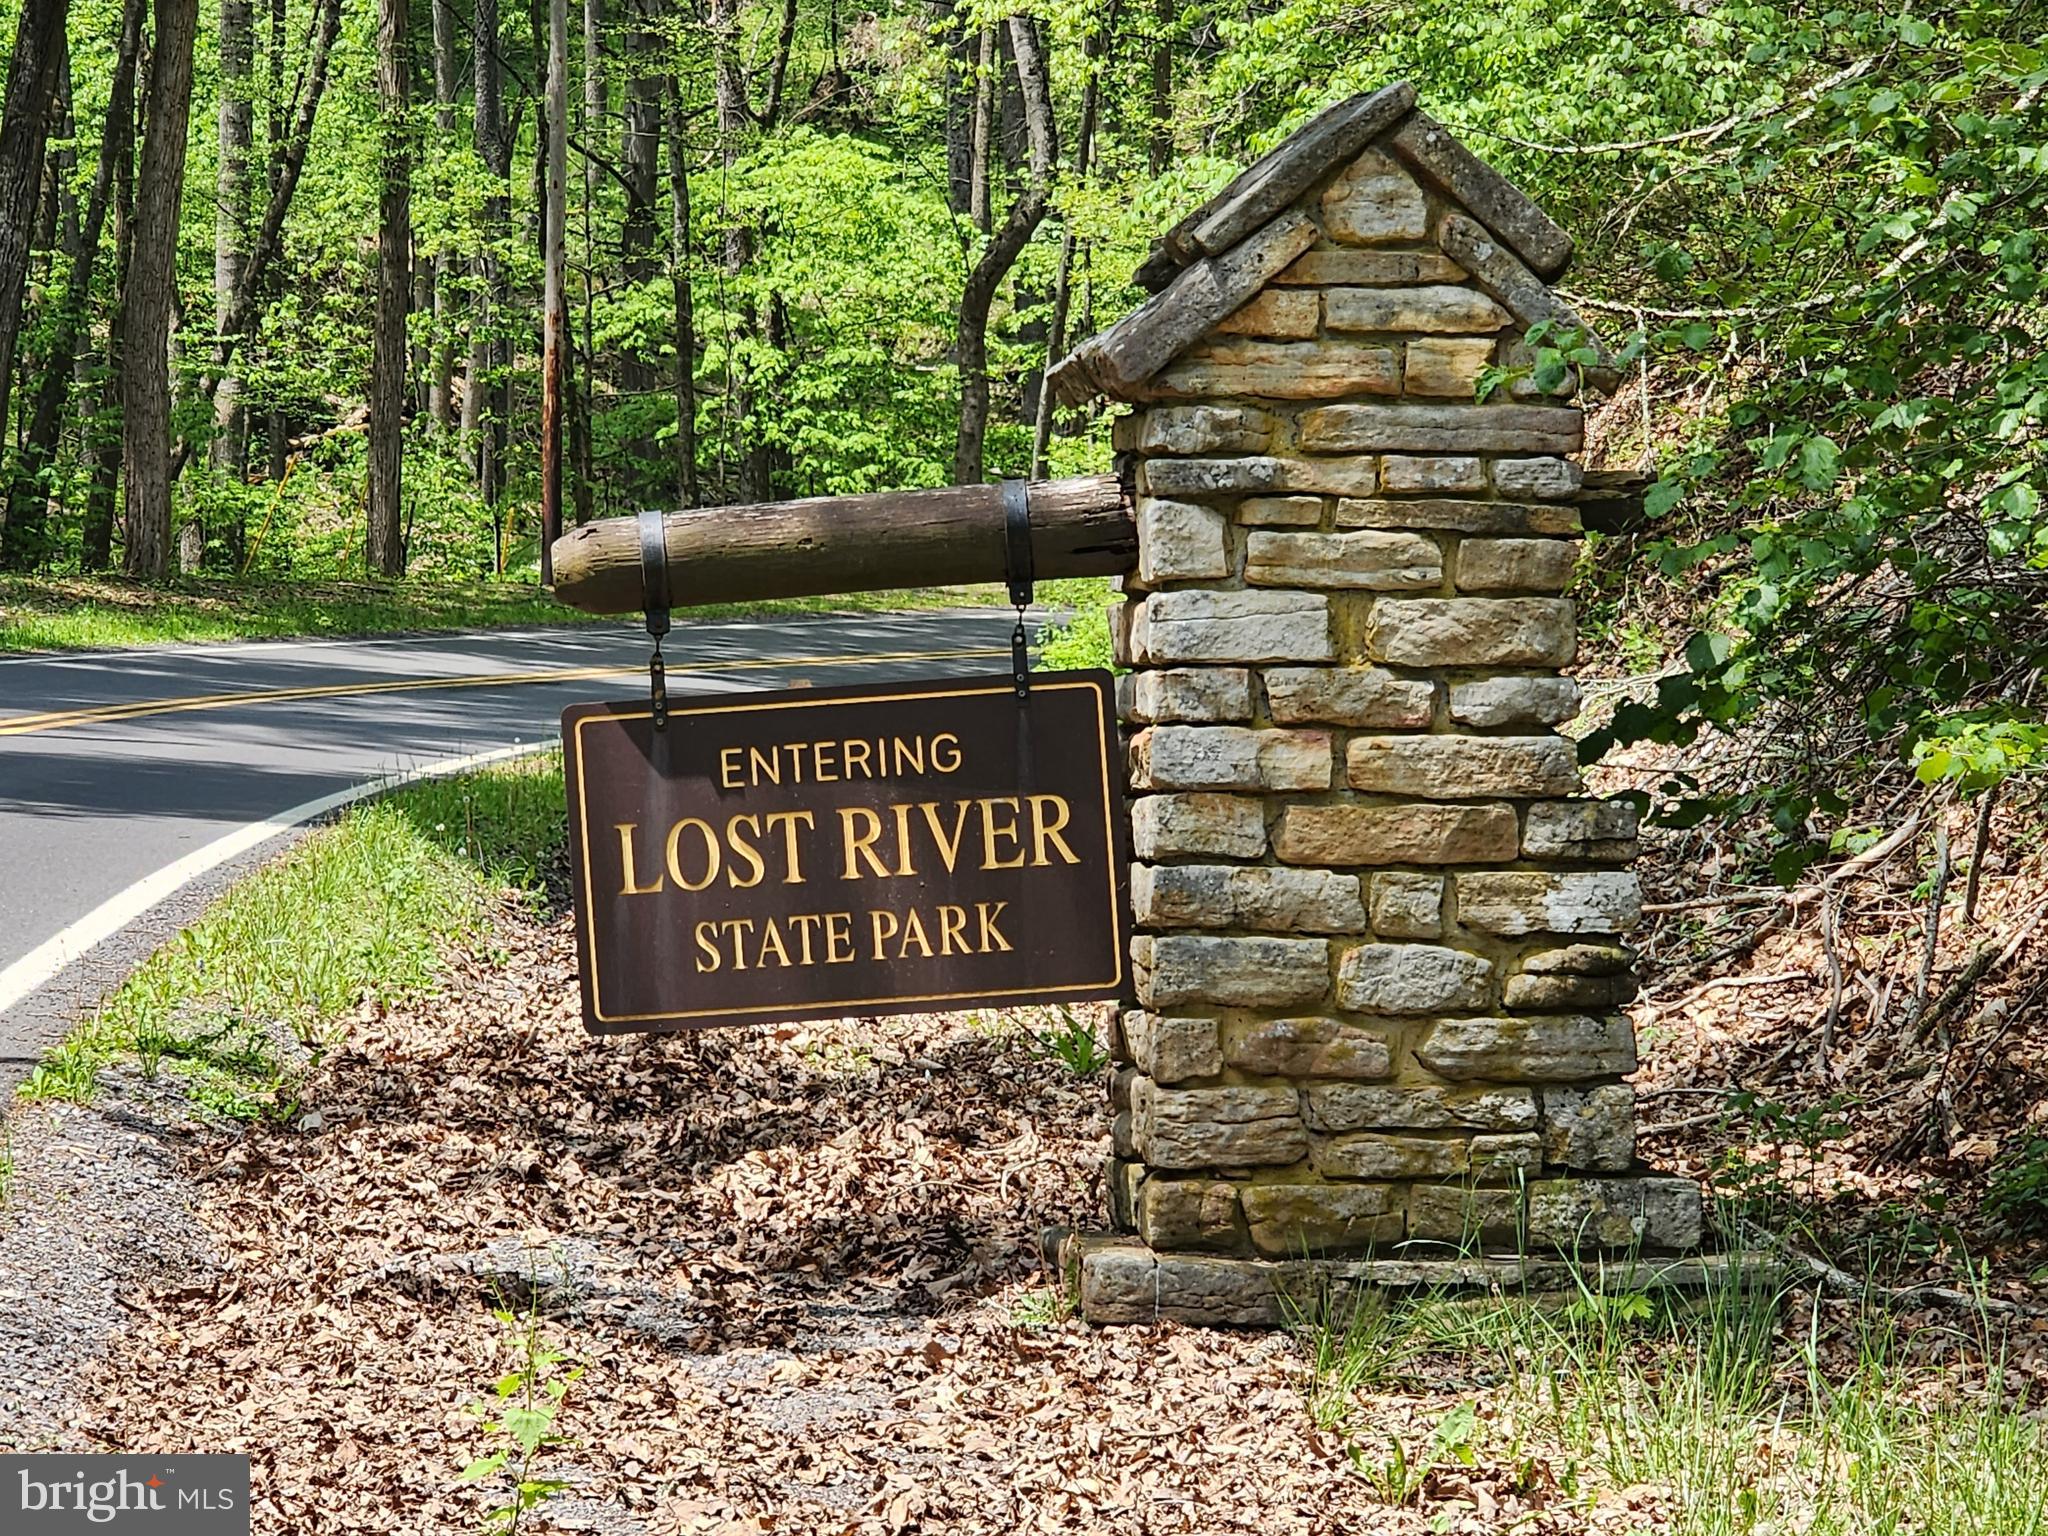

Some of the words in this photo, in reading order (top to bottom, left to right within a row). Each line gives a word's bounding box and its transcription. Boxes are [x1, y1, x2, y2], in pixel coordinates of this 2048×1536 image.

[721, 733, 962, 789] ENTERING
[614, 810, 815, 895] LOST
[836, 794, 1081, 880] RIVER
[695, 911, 856, 973] STATE
[870, 901, 1014, 961] PARK
